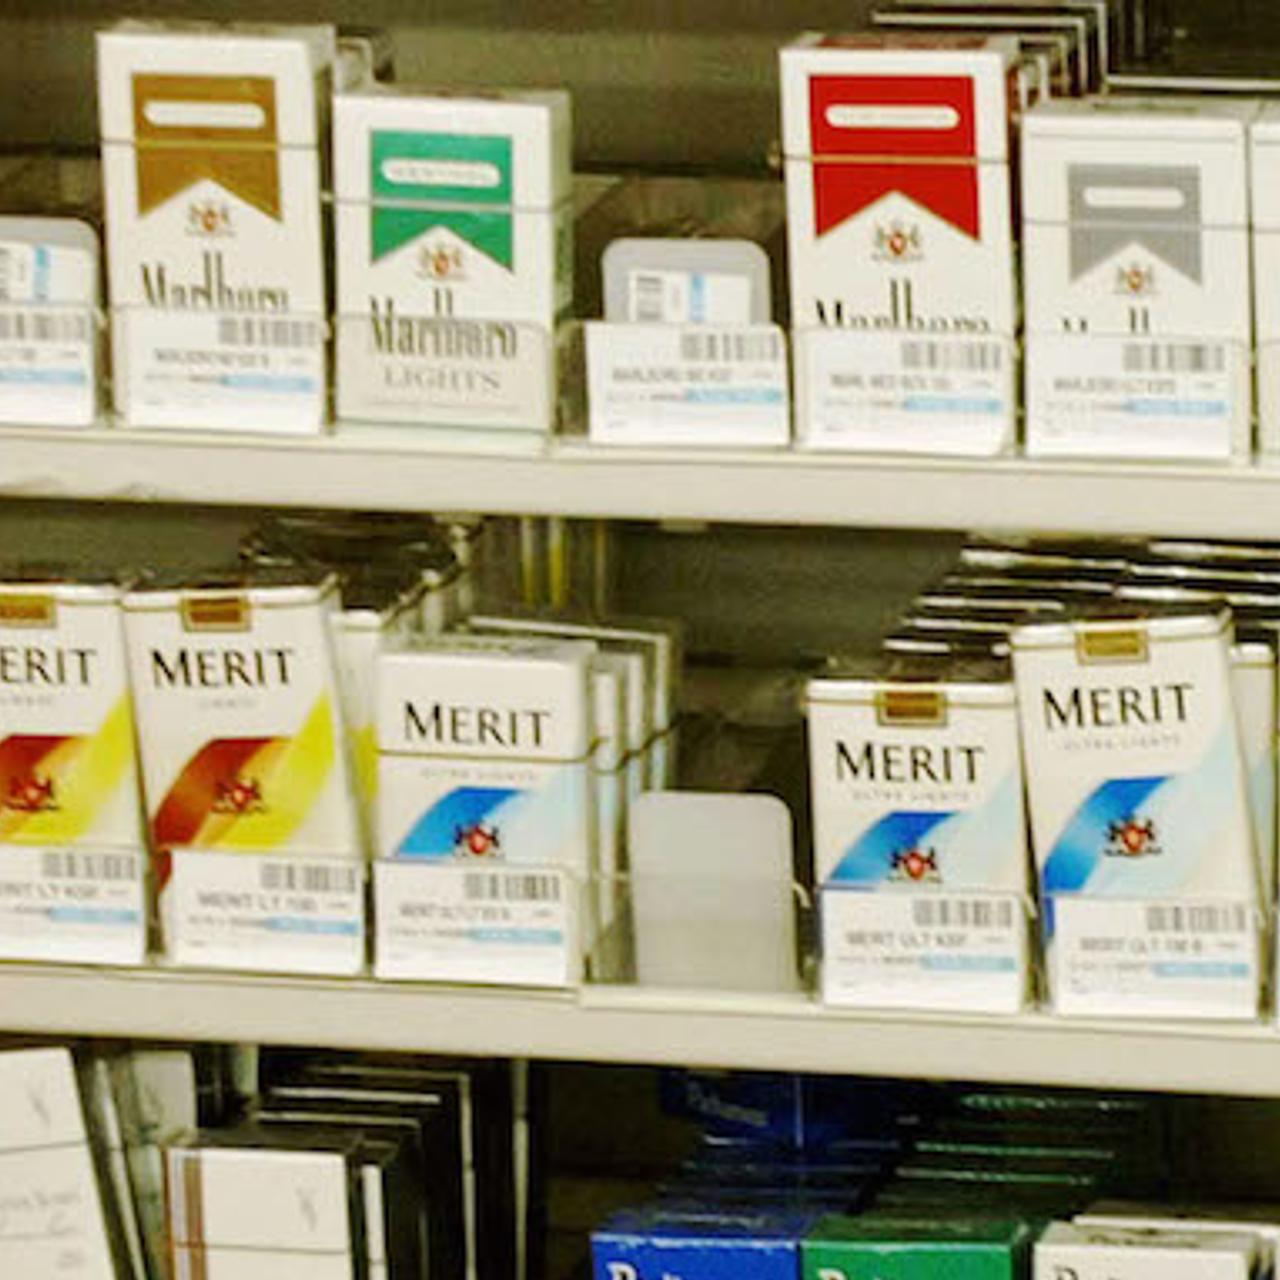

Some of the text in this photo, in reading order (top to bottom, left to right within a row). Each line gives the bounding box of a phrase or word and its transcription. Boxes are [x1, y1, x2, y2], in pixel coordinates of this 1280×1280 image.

[370, 289, 516, 359] Marlboro
[384, 368, 501, 391] LIGHTS
[153, 649, 292, 687] MERIT
[405, 702, 550, 746] MERIT
[1042, 684, 1192, 730] MERIT
[834, 740, 983, 783] MERIT
